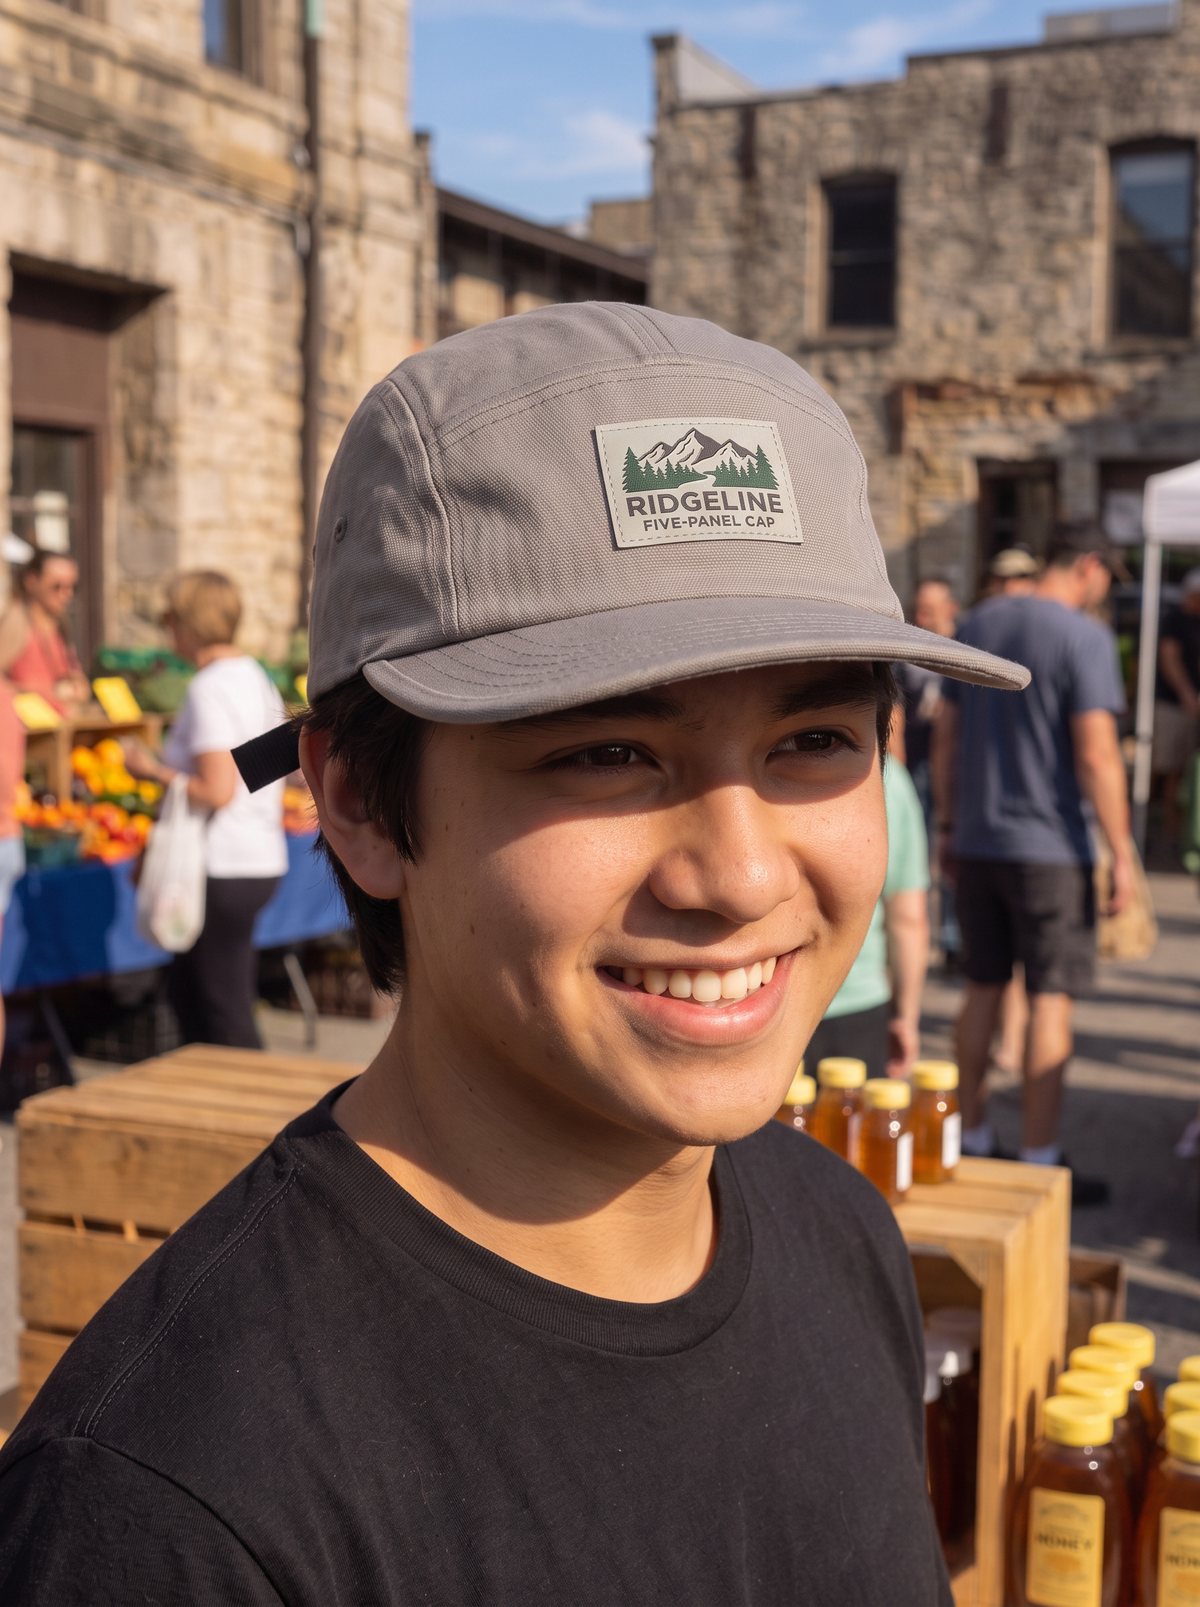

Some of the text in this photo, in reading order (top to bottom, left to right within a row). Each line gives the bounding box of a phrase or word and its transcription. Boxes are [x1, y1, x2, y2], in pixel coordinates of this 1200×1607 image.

[626, 491, 784, 517] RIDGELINE
[643, 515, 775, 531] FIVE-PANEL CAP
